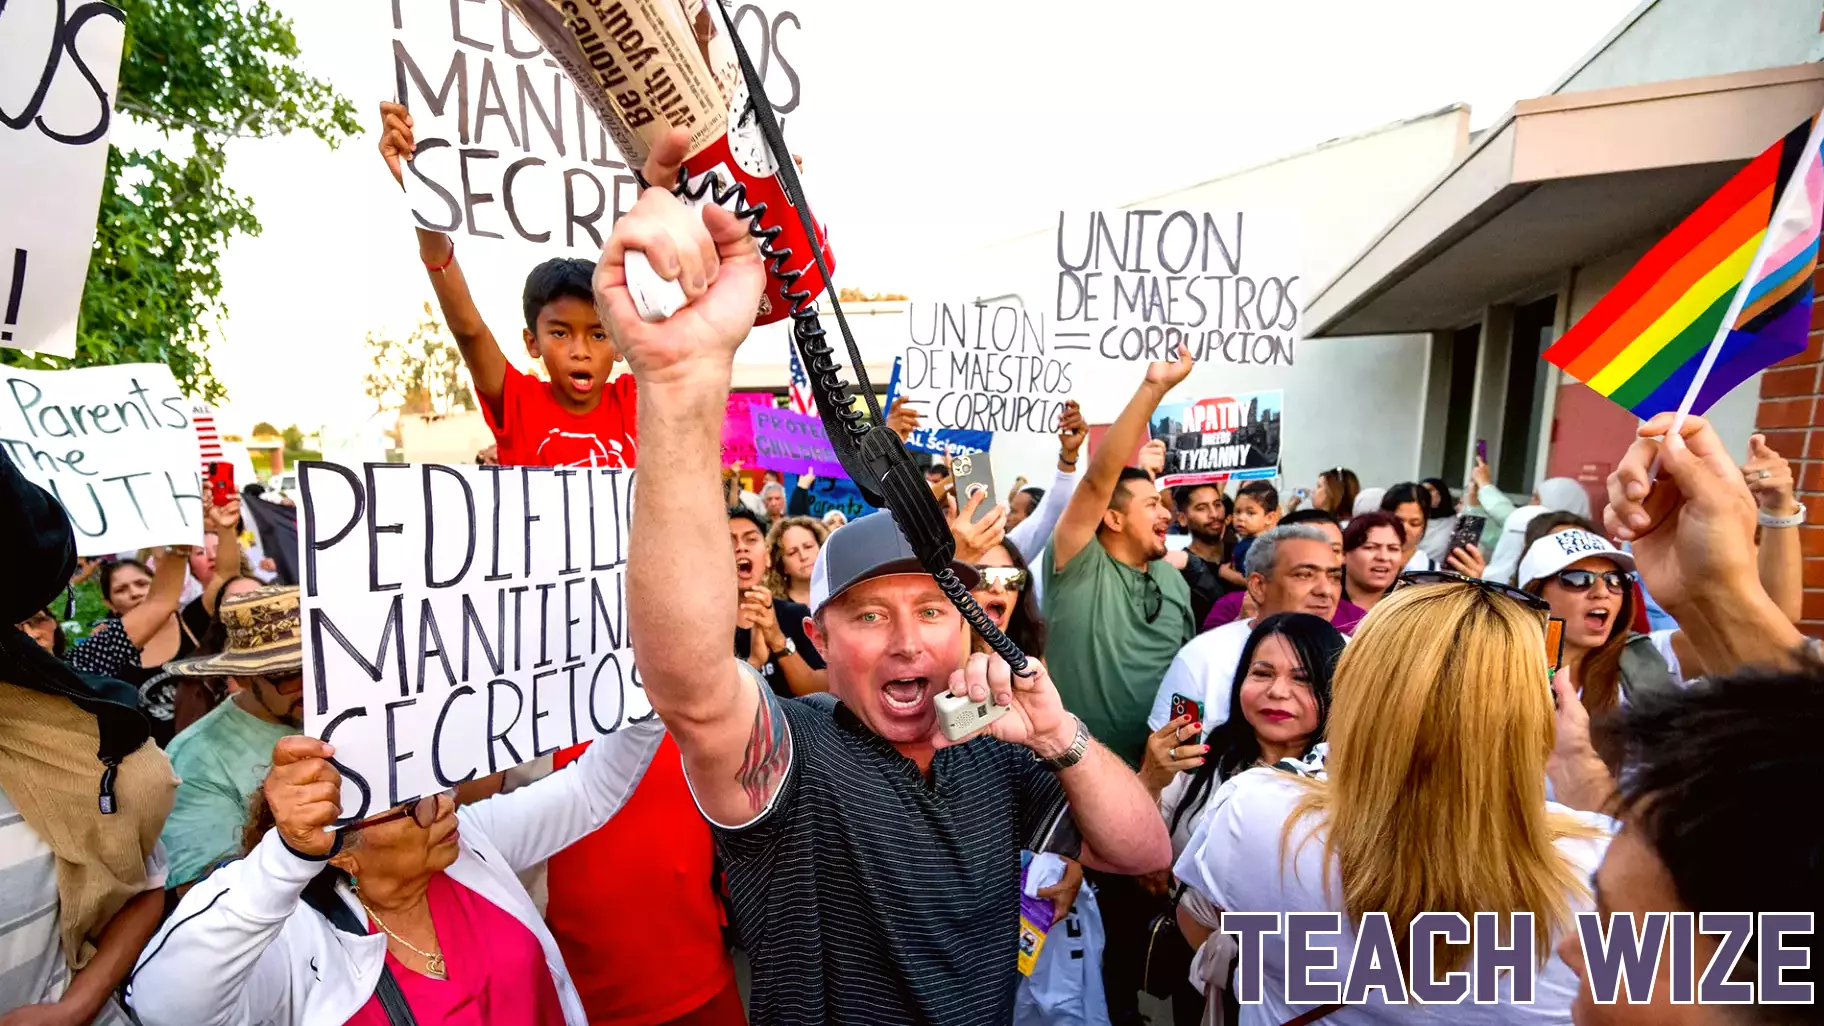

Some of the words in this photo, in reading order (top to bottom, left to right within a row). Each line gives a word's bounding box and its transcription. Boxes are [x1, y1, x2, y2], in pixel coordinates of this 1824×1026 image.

[561, 0, 628, 89] hones
[616, 89, 655, 129] Be
[1057, 210, 1243, 275] UNION
[1057, 270, 1102, 321] DE
[1114, 275, 1299, 331] MAESTROS
[909, 301, 1045, 355] UNION
[1100, 325, 1293, 365] CORRUPCION
[906, 346, 943, 390] DE
[950, 350, 1072, 394] MAESTROS
[7, 378, 188, 437] Parents
[757, 413, 827, 439] PROTE
[936, 391, 1067, 434] CORRUPCIO
[1182, 401, 1251, 433] APATHY
[0, 438, 98, 475] The
[1179, 444, 1251, 470] TYRANNY
[49, 471, 202, 537] UTH
[298, 460, 638, 597] PEDIFILI
[309, 572, 633, 716] MANTIEN
